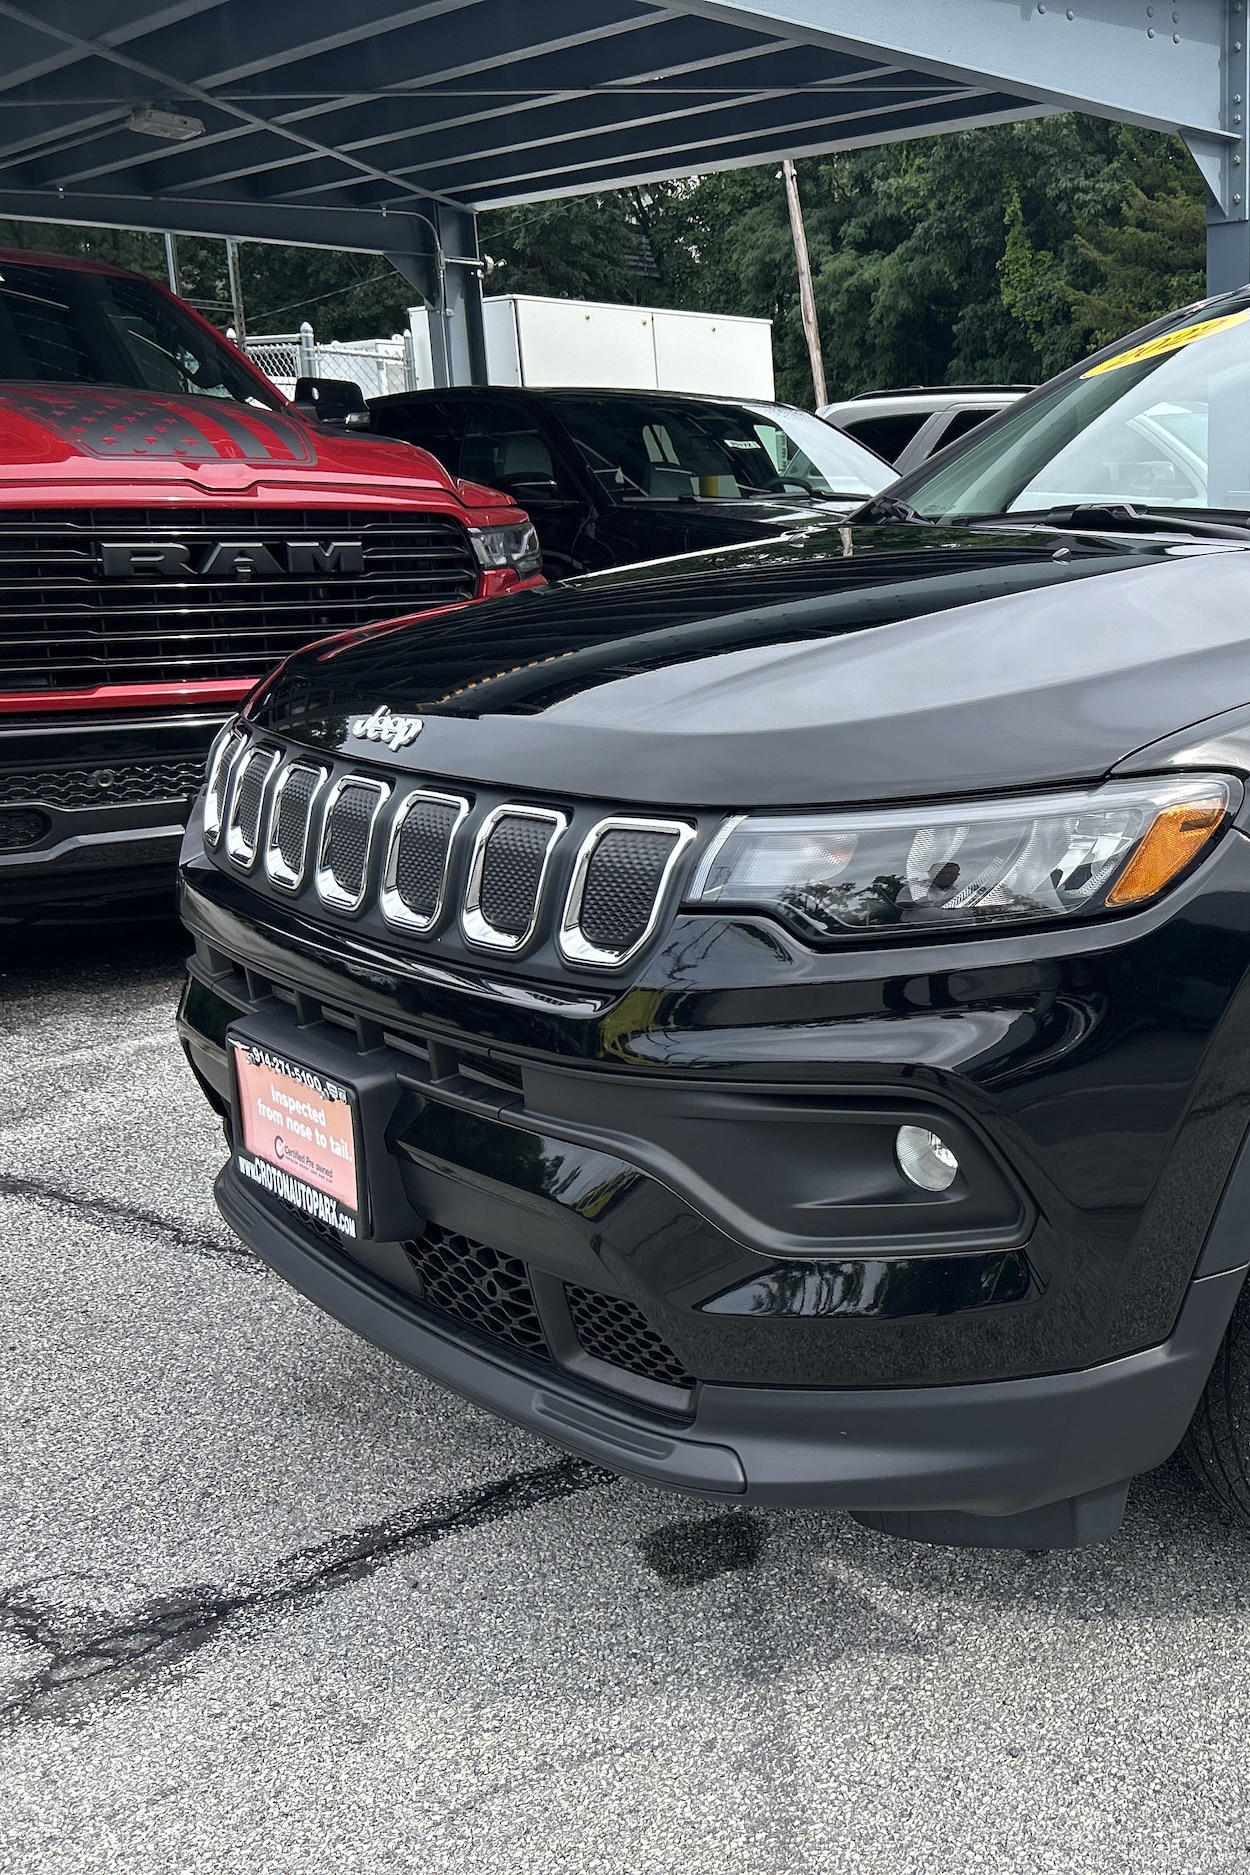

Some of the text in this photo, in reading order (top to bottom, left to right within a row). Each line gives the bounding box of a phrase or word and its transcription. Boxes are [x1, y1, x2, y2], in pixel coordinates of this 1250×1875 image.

[1103, 319, 1228, 371] 2022
[101, 541, 365, 576] RAM
[352, 704, 424, 753] Jeep
[257, 1097, 353, 1162] from nose to tail.
[270, 1082, 327, 1128] Inspected
